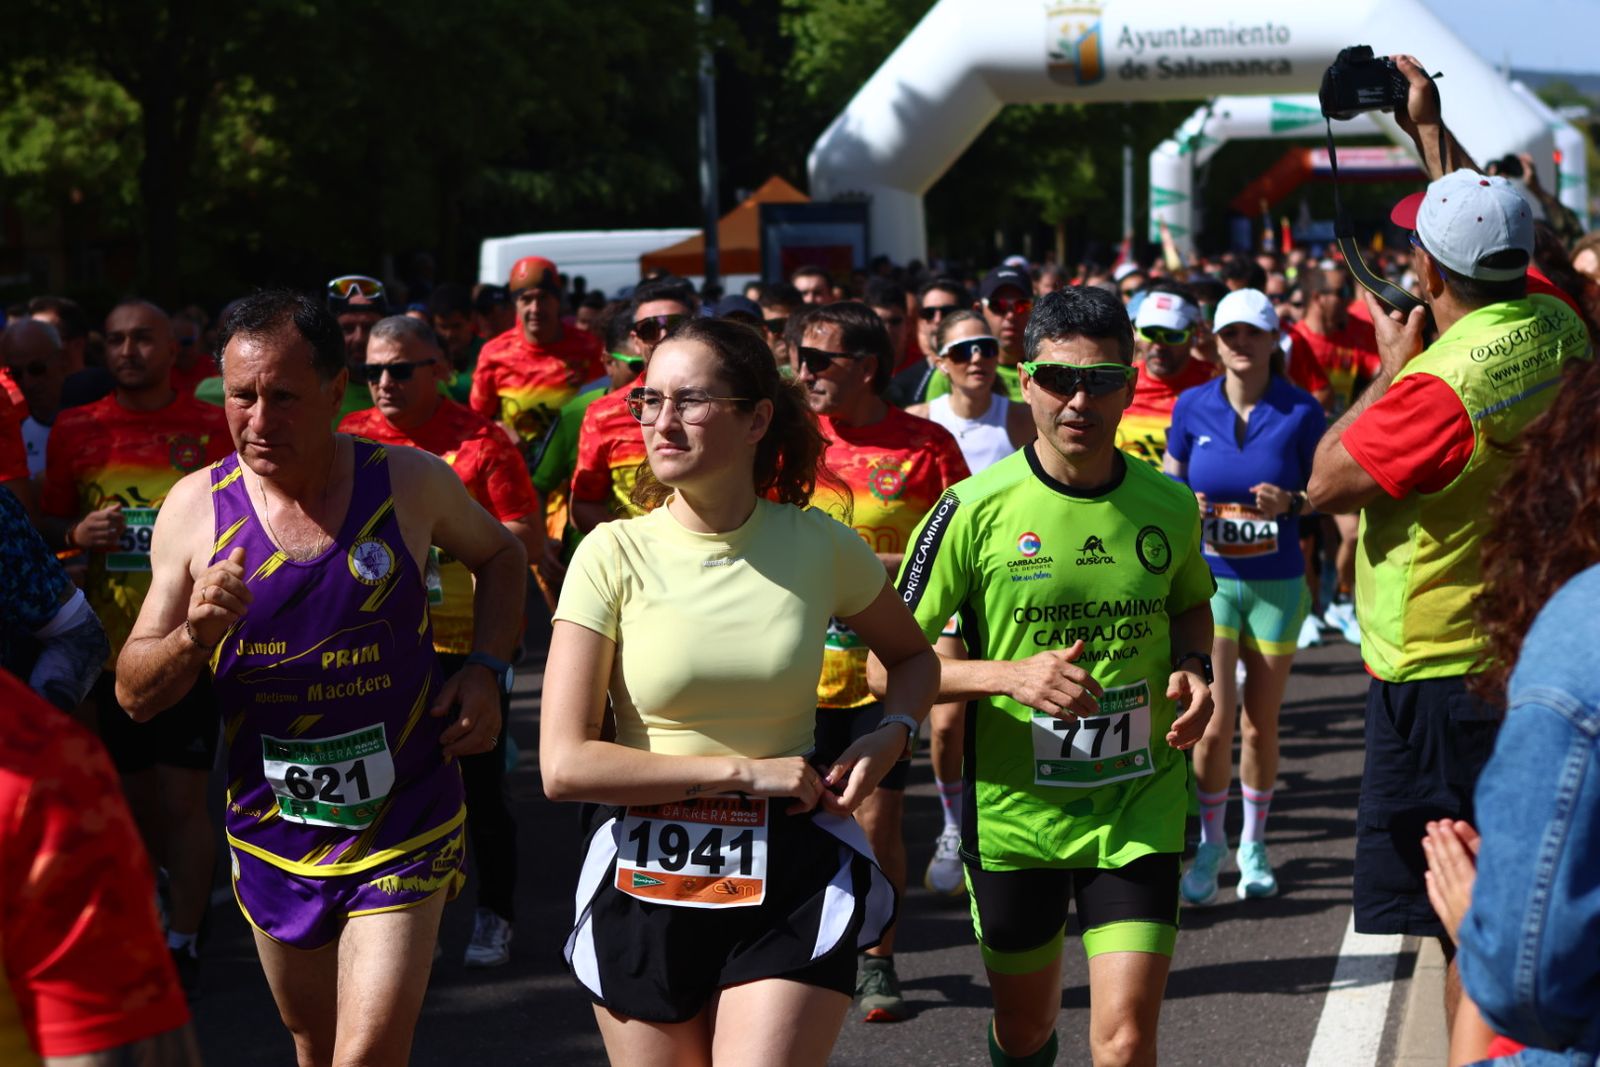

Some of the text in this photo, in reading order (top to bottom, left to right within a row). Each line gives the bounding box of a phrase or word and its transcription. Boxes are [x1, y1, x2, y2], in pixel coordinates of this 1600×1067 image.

[1117, 21, 1291, 54] Ayuntamiento
[1119, 55, 1292, 80] de Salamanca
[121, 526, 153, 552] 59
[1207, 520, 1274, 543] 1804
[903, 497, 953, 605] ORRECAMINOS
[1007, 556, 1053, 568] CARBAJOSA
[1014, 598, 1167, 624] CORRECAMINO
[236, 637, 287, 656] Jamón
[1033, 621, 1153, 646] CARBAJOSA
[322, 643, 381, 670] PRIM
[1074, 646, 1139, 663] AMANCA
[307, 673, 392, 702] Macotera
[1053, 713, 1130, 758] 771
[285, 759, 371, 804] 621
[662, 805, 728, 821] CARRERA
[628, 820, 754, 876] 1941
